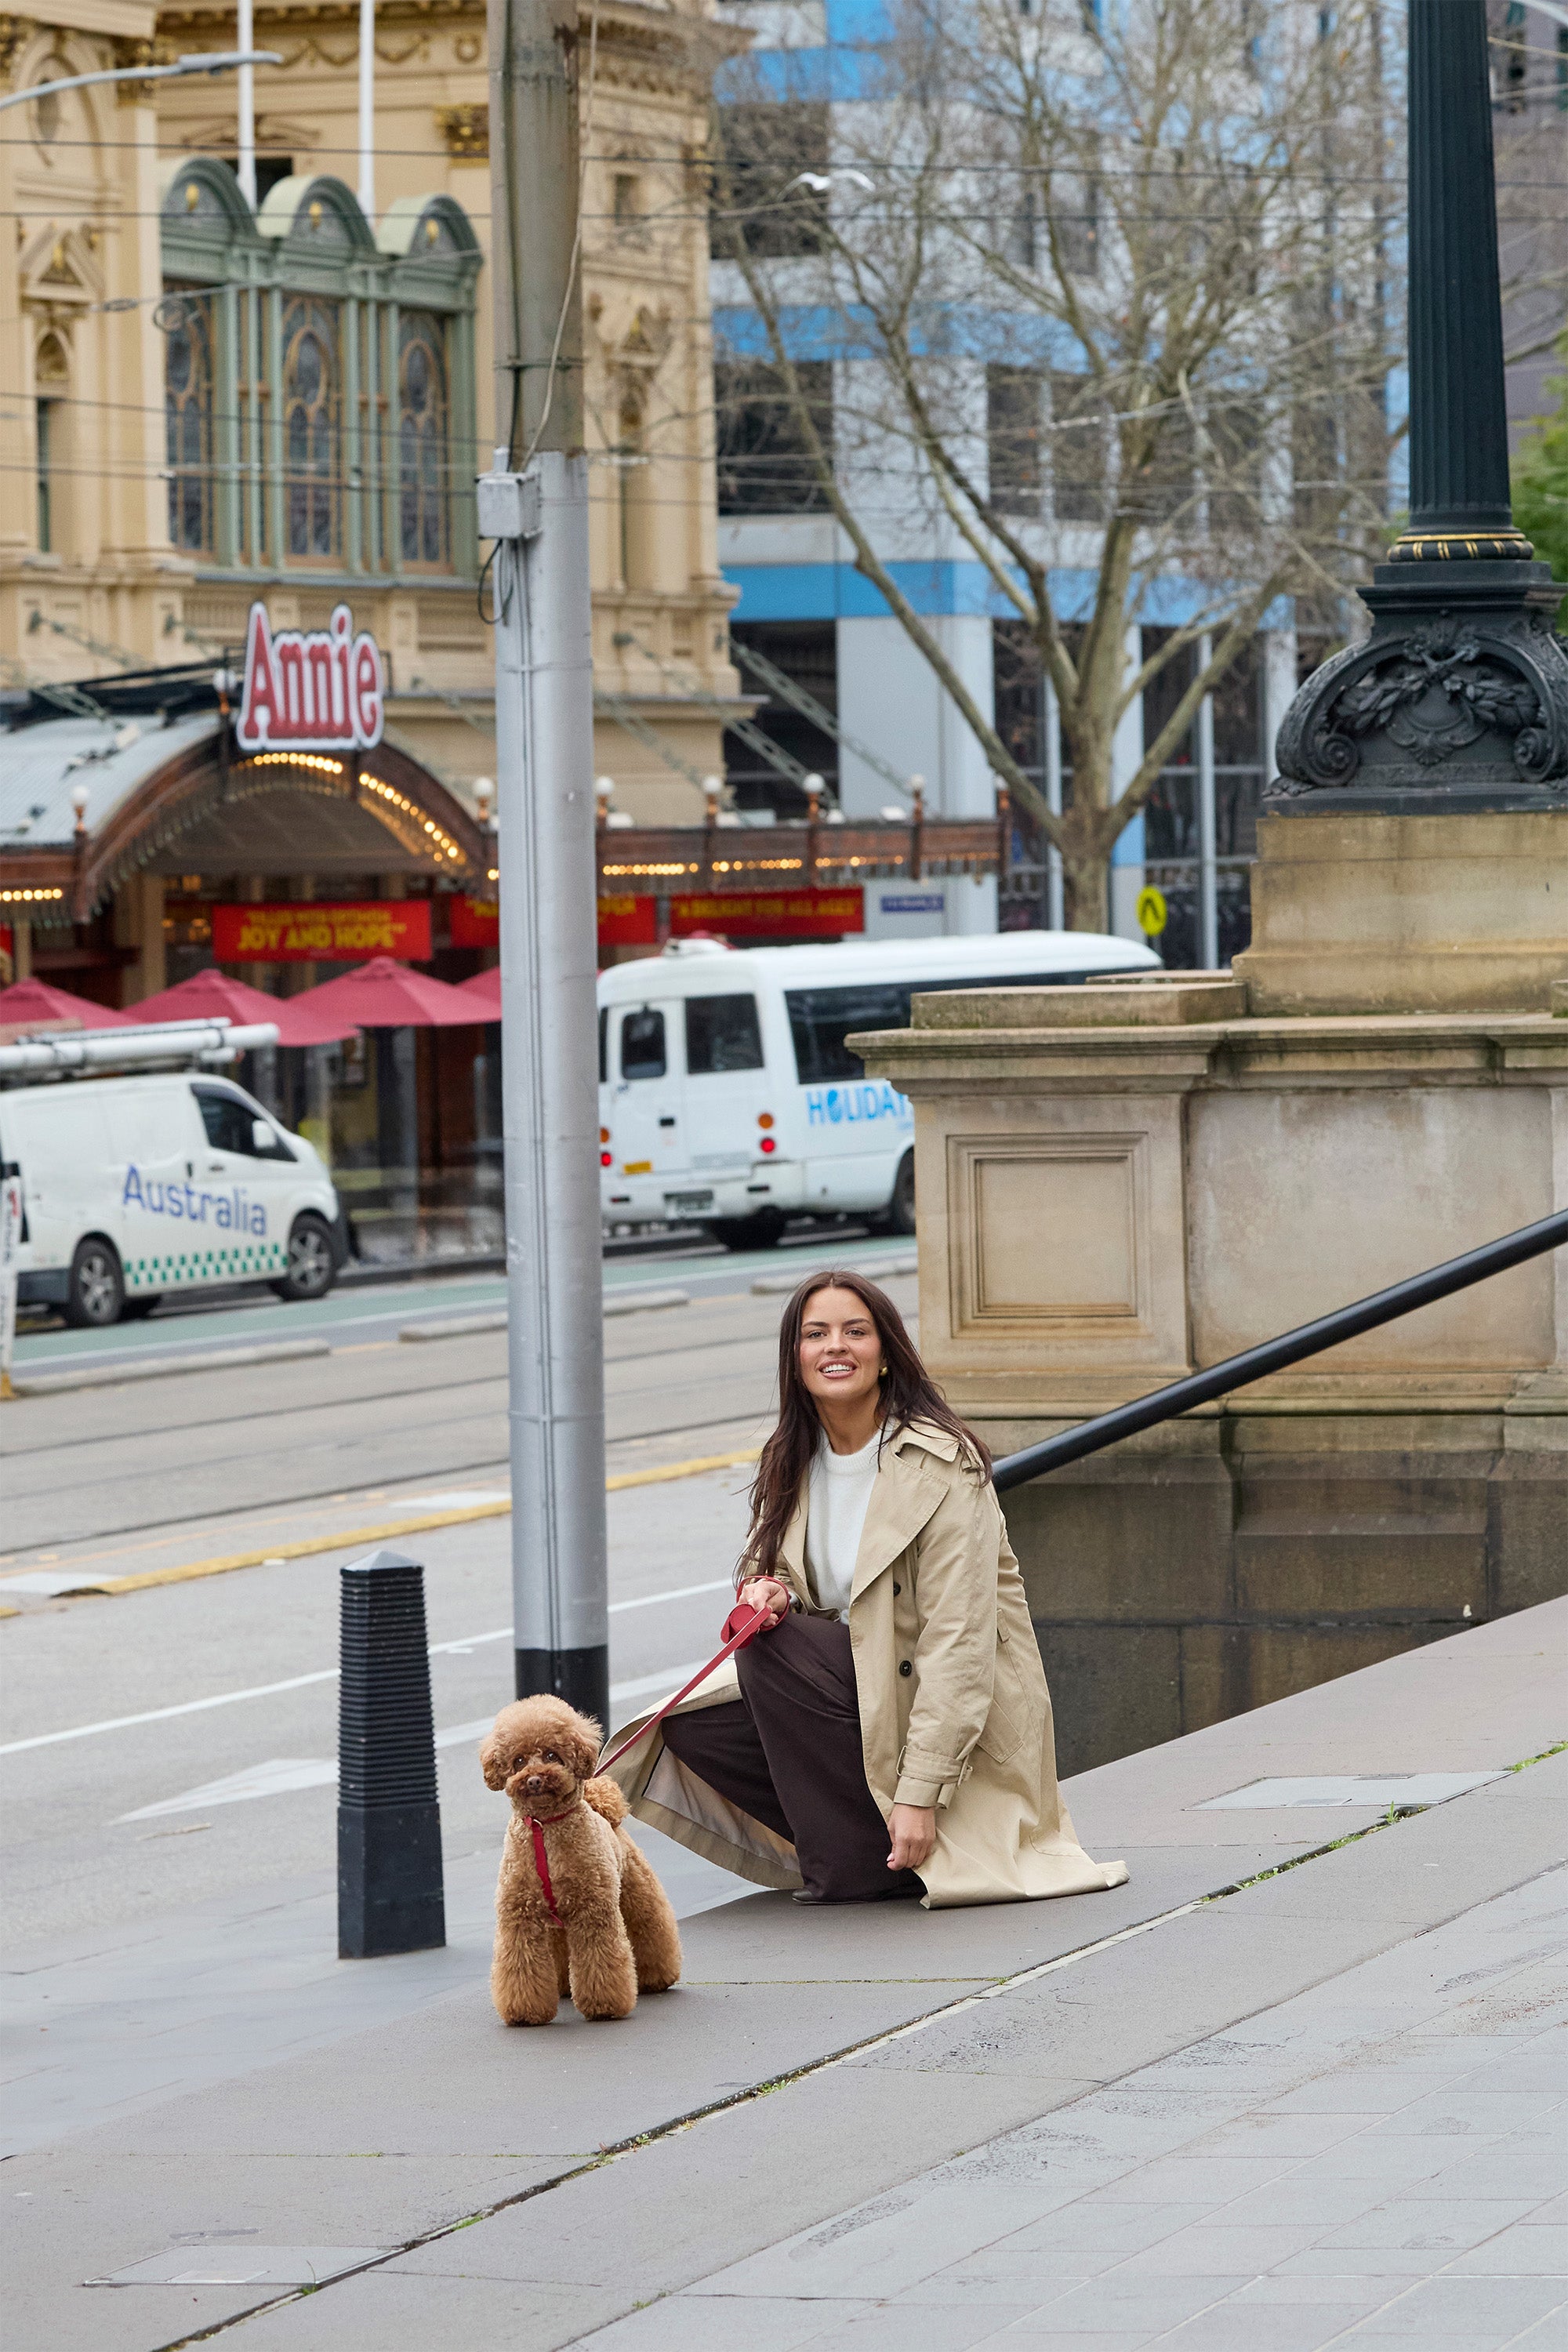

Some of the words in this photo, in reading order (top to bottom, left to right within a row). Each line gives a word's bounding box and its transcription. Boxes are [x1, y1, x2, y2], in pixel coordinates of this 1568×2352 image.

[238, 604, 383, 748] Annie
[238, 924, 281, 951] JOY
[285, 923, 332, 949] AND
[123, 1163, 267, 1237] Australia
